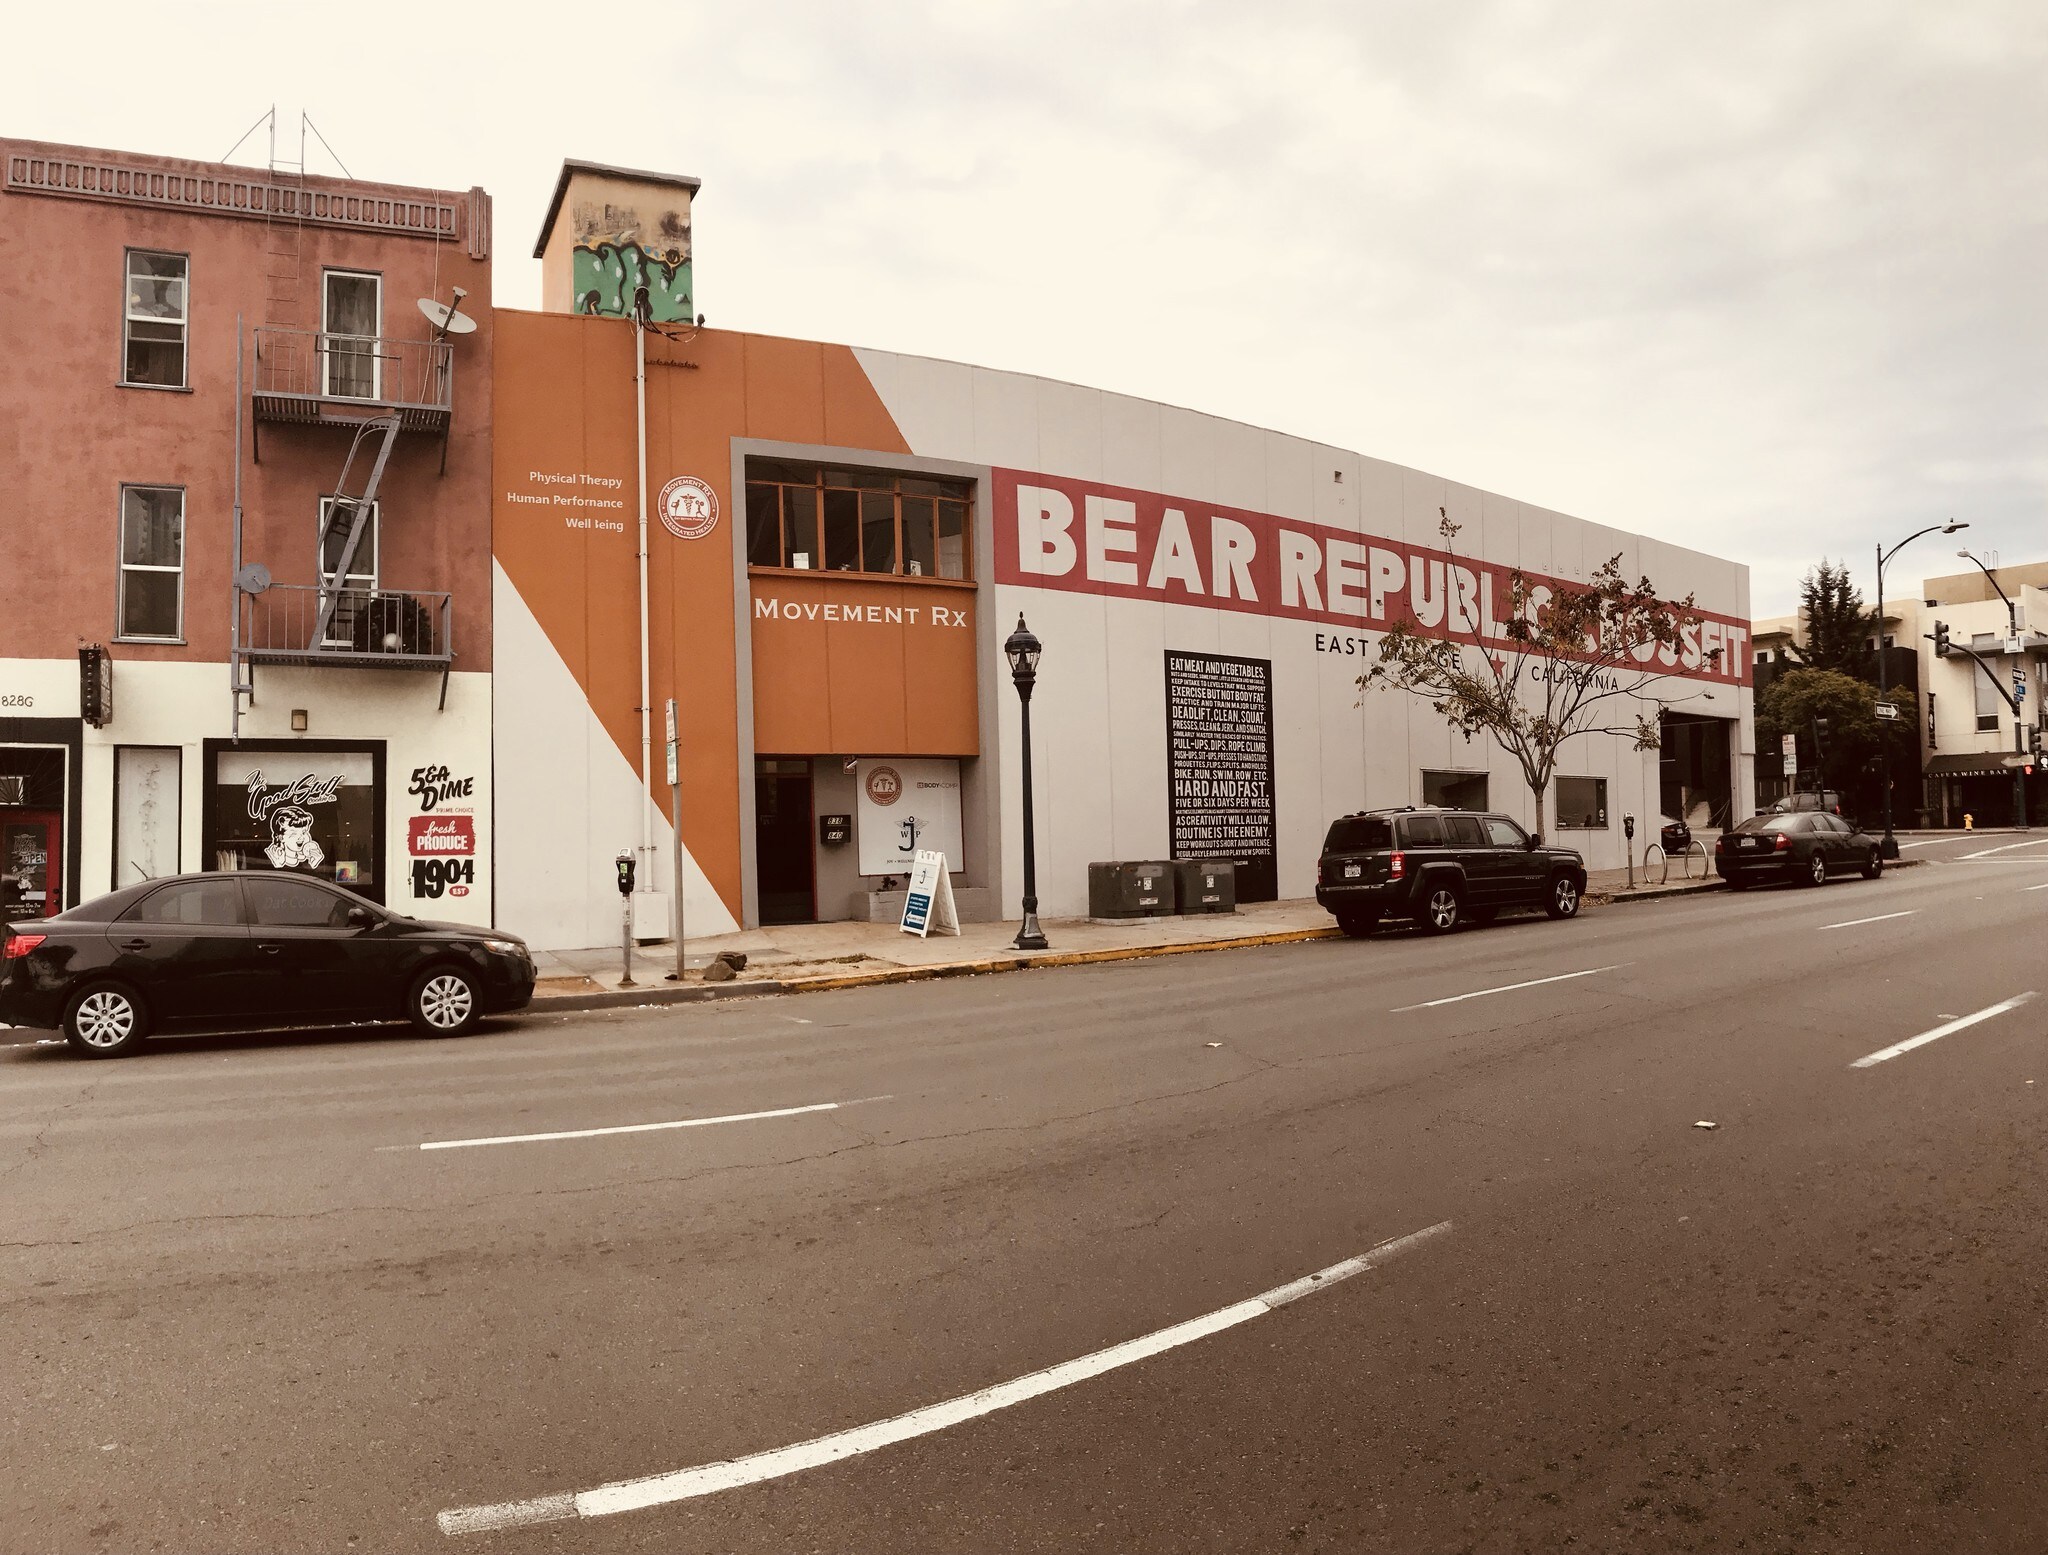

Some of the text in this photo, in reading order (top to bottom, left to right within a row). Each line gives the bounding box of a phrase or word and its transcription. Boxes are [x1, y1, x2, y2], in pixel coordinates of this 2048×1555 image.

[529, 471, 622, 489] Physical Therapy
[665, 479, 702, 495] MOVEMENT
[507, 492, 550, 505] Human
[566, 518, 591, 528] Well
[663, 512, 715, 536] INTEGRATED HEALTH
[1017, 484, 1259, 602] BEAR
[755, 598, 920, 625] MOVEMENT
[1315, 633, 1370, 657] EAST
[1170, 658, 1184, 671] EAT
[1184, 659, 1204, 672] MEAT
[1206, 662, 1220, 674] AND
[1, 694, 34, 707] 828G
[1172, 686, 1266, 703] EXERCISE BUT NOT BODY FAT.
[1172, 697, 1200, 706] PRACTICE
[1214, 700, 1230, 708] TRAIN
[1229, 741, 1245, 751] ROPE
[248, 773, 346, 821] Good Stuff
[421, 777, 474, 812] DIME
[1175, 780, 1269, 798] HARD AND FAST.
[1176, 798, 1270, 807] FIVE OR SIX DAYS PER WEEK
[424, 820, 457, 836] fresh
[1176, 816, 1185, 826] AS
[1186, 815, 1227, 826] CREATIVITY
[1228, 815, 1245, 825] WILL
[1176, 826, 1271, 839] ROUTINE IS THE ENEMY.
[417, 835, 468, 851] PRODUCE
[1190, 840, 1219, 848] WORKOUTS
[1238, 839, 1248, 847] AND
[452, 887, 467, 895] EST
